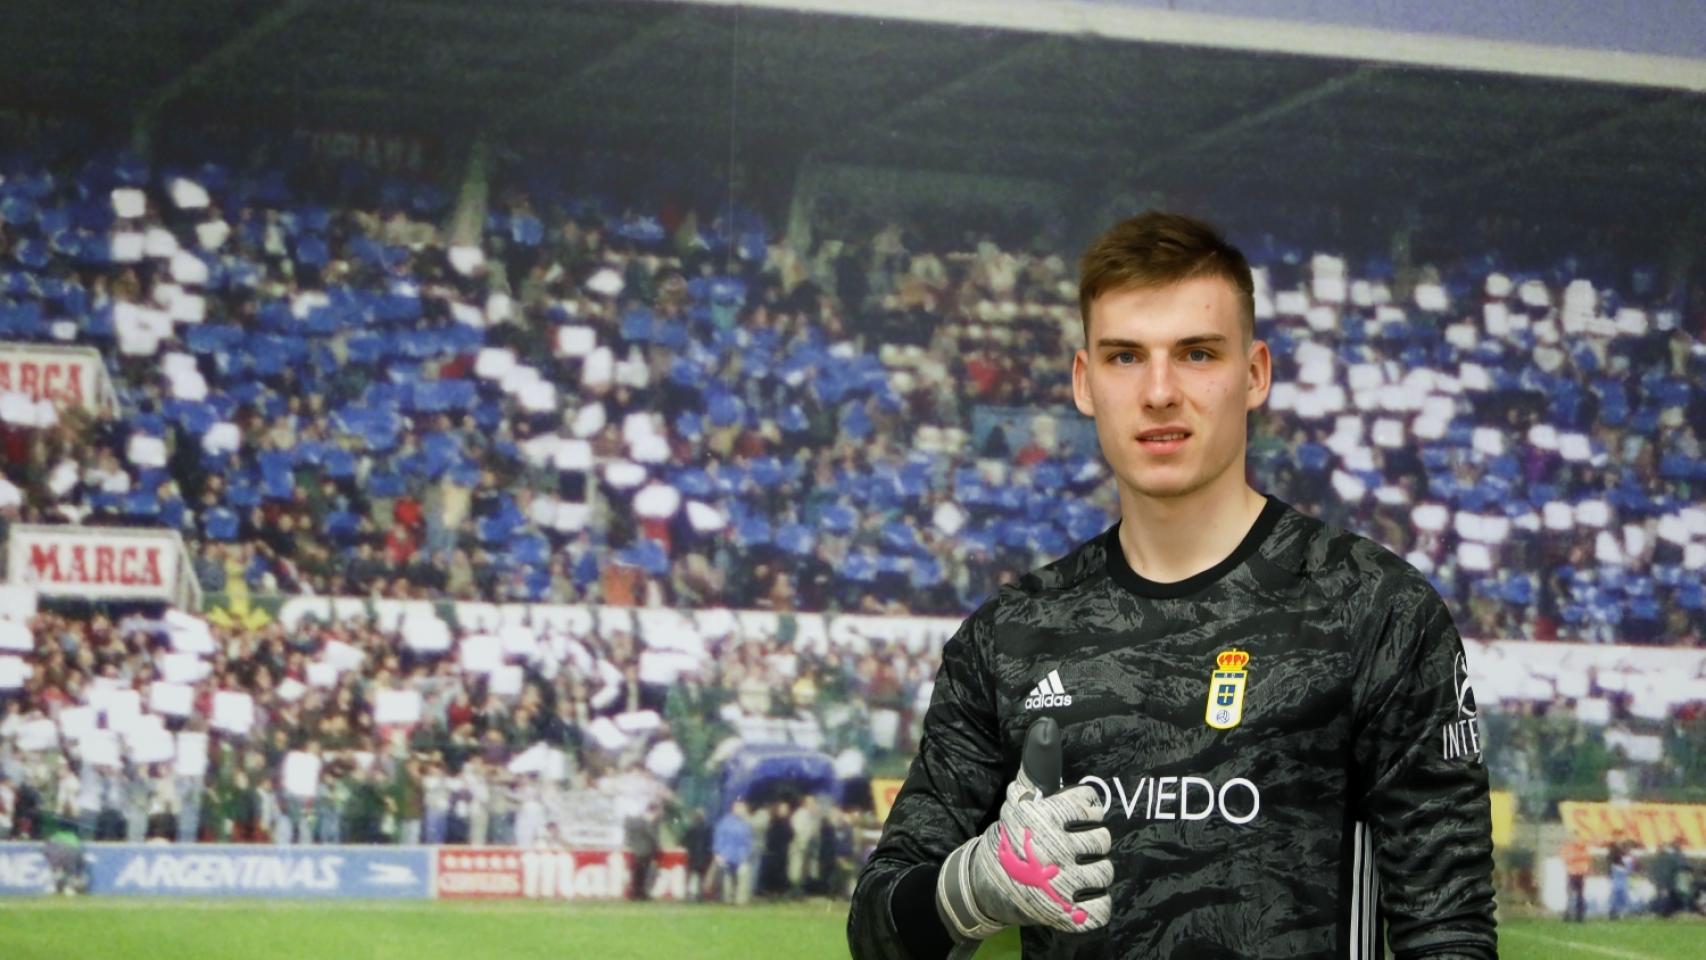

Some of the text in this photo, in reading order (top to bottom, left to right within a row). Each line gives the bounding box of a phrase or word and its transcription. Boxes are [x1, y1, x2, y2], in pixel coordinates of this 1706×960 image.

[30, 544, 162, 586] MARCA
[1025, 692, 1072, 710] adidas
[115, 855, 344, 889] ARGENTINAS
